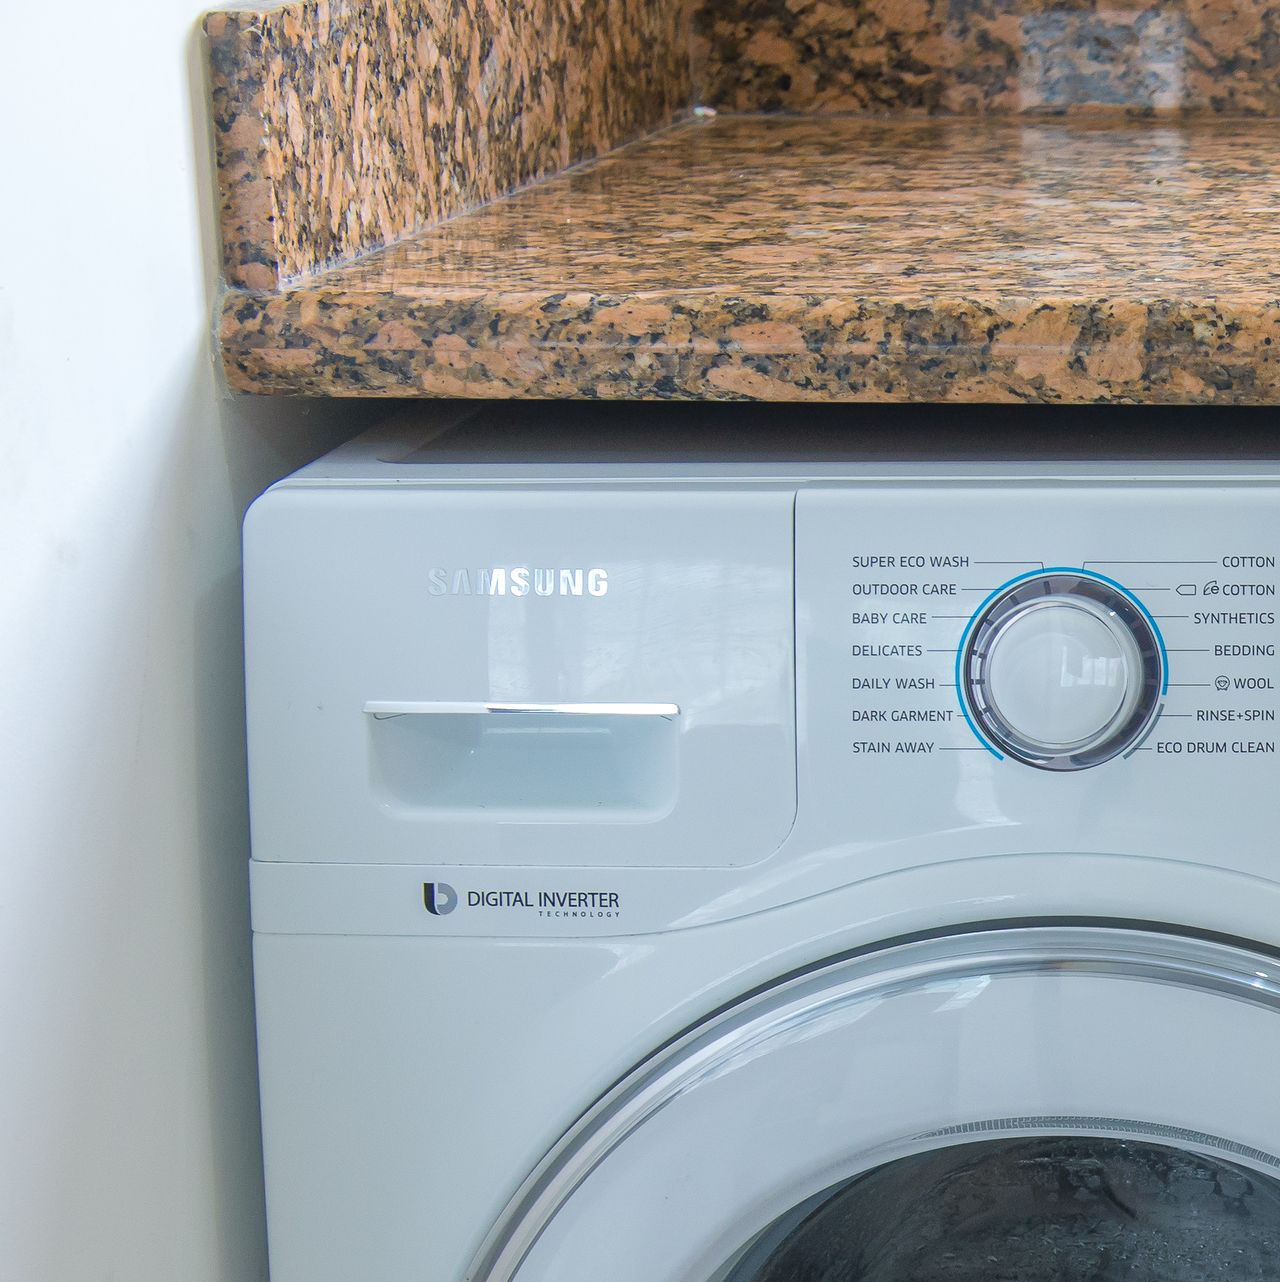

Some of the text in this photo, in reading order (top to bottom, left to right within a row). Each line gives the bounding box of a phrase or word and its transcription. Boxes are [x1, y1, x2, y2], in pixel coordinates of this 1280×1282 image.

[852, 556, 969, 568] SUPER ECO WASH
[1222, 556, 1276, 568] COTTON
[427, 567, 609, 597] SAMSUNG
[852, 584, 957, 596] OUTDOOR CARE
[1222, 584, 1276, 596] COTTON
[852, 613, 928, 625] BABY CARE
[1194, 612, 1276, 625] SYNTHETICS
[852, 645, 923, 657] DELICATES
[1214, 645, 1276, 657] BEDDING
[852, 678, 935, 690] DAILY WASH
[1233, 678, 1275, 690] WOOL
[852, 710, 953, 722] DARK GARMENT
[1196, 709, 1276, 722] RINSE+SPIN
[852, 742, 935, 754] STAIN AWAY
[1156, 742, 1276, 754] ECO DRUM CLEAN
[467, 891, 620, 908] DIGITAL INVERTER
[539, 910, 621, 918] TECHNOLOGY
